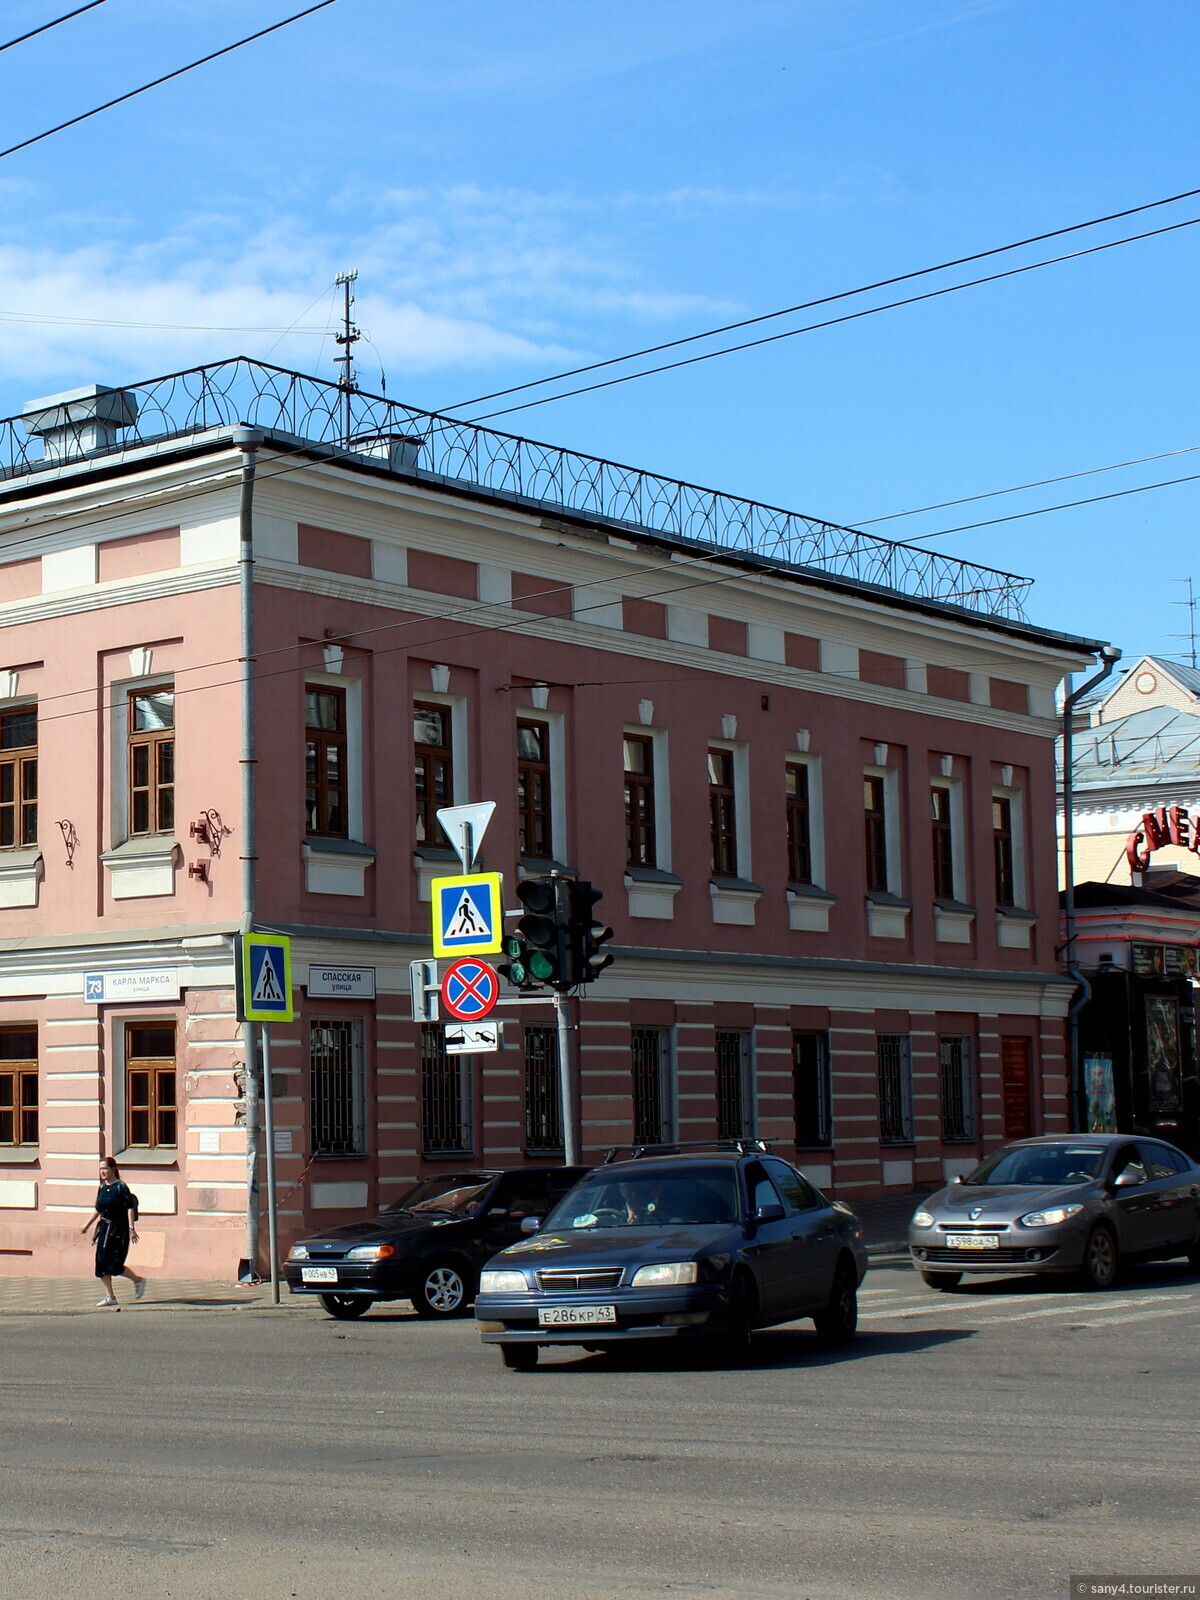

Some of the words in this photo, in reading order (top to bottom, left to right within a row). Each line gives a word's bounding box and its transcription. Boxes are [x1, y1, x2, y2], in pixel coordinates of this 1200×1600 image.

[112, 977, 137, 986] КАРЛА
[139, 975, 171, 985] МАРКСА
[322, 972, 361, 982] СПАССКАЯ
[87, 980, 102, 995] 73
[543, 1309, 594, 1322] Е286КР
[597, 1307, 611, 1318] 43
